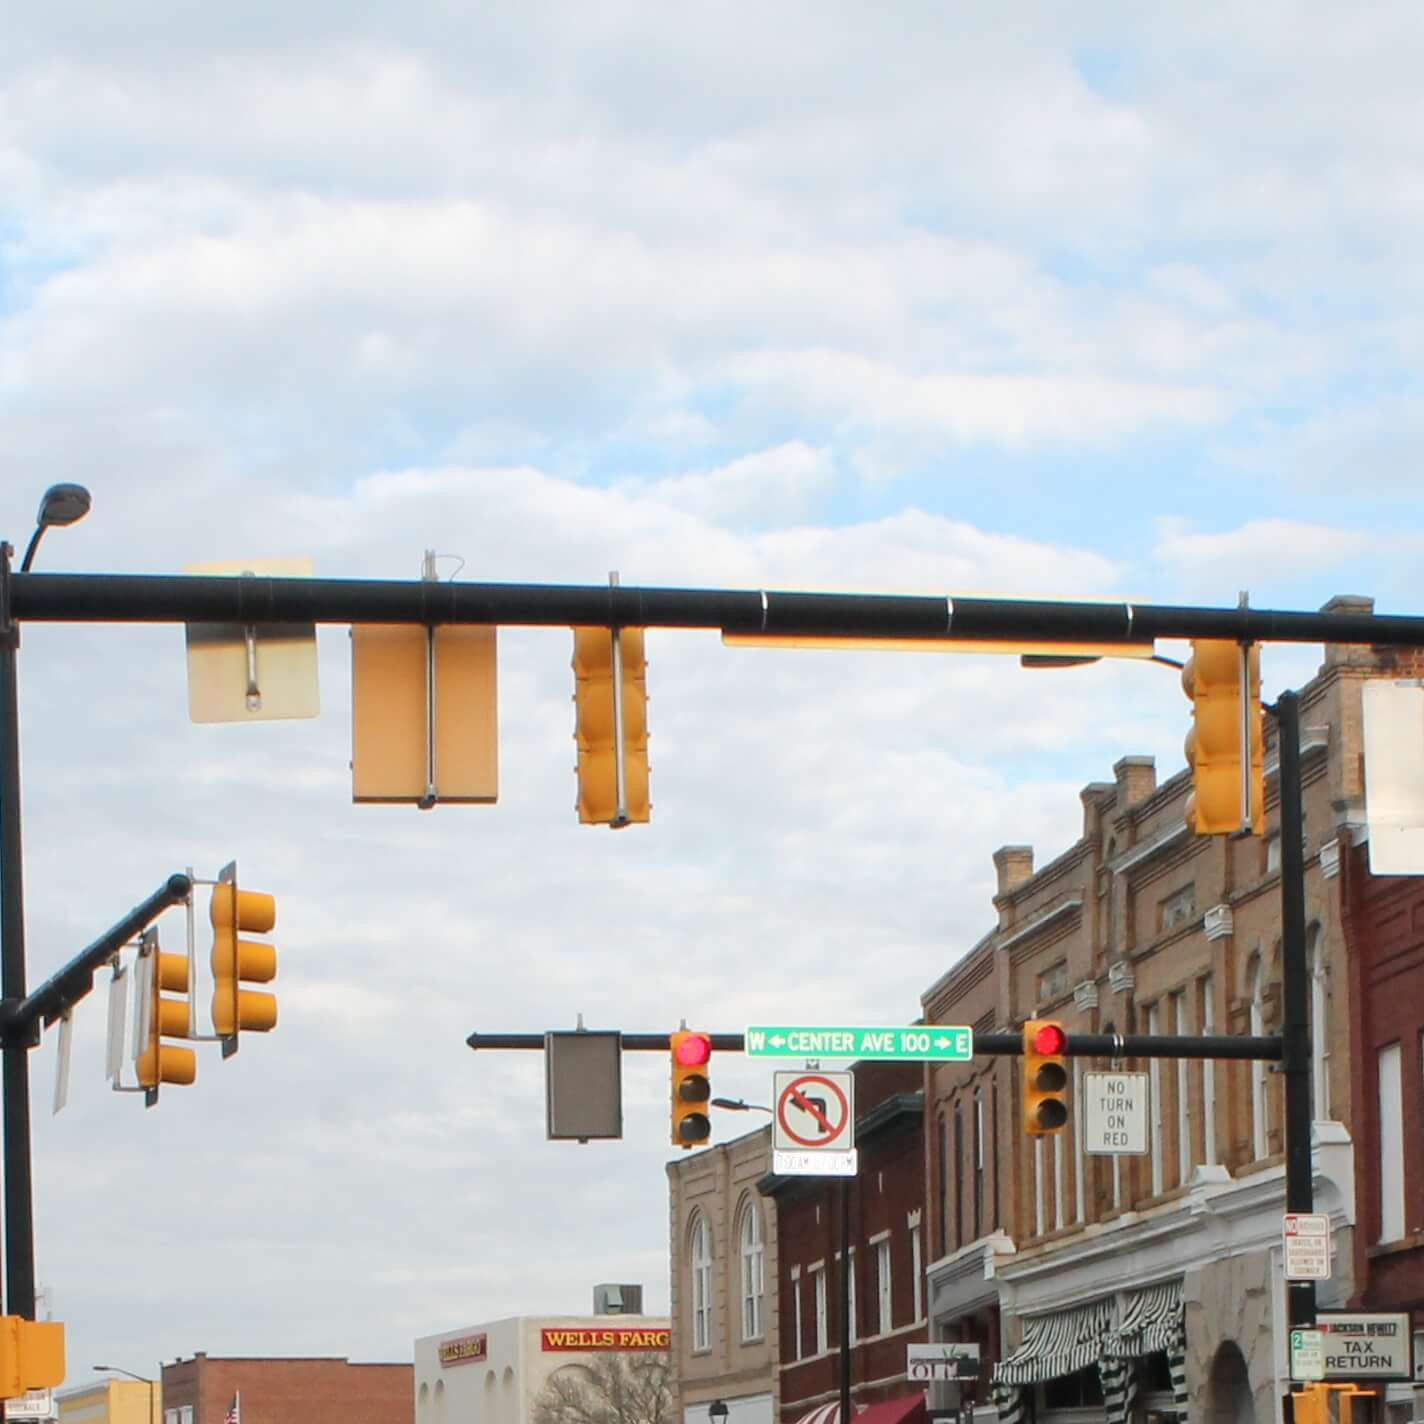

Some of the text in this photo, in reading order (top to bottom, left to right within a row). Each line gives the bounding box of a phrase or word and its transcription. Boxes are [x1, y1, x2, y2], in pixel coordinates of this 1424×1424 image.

[749, 1032, 967, 1053] W CENTER AVE 100 E
[1107, 1081, 1125, 1095] NO
[1099, 1098, 1133, 1112] TURN
[1107, 1115, 1125, 1128] ON
[1104, 1132, 1128, 1146] RED
[1328, 1323, 1397, 1336] JACKSON HEWITT
[546, 1332, 671, 1347] WELLS FARG
[1294, 1333, 1302, 1348] 2
[1344, 1342, 1374, 1353] TAX
[1326, 1356, 1392, 1368] RETURN
